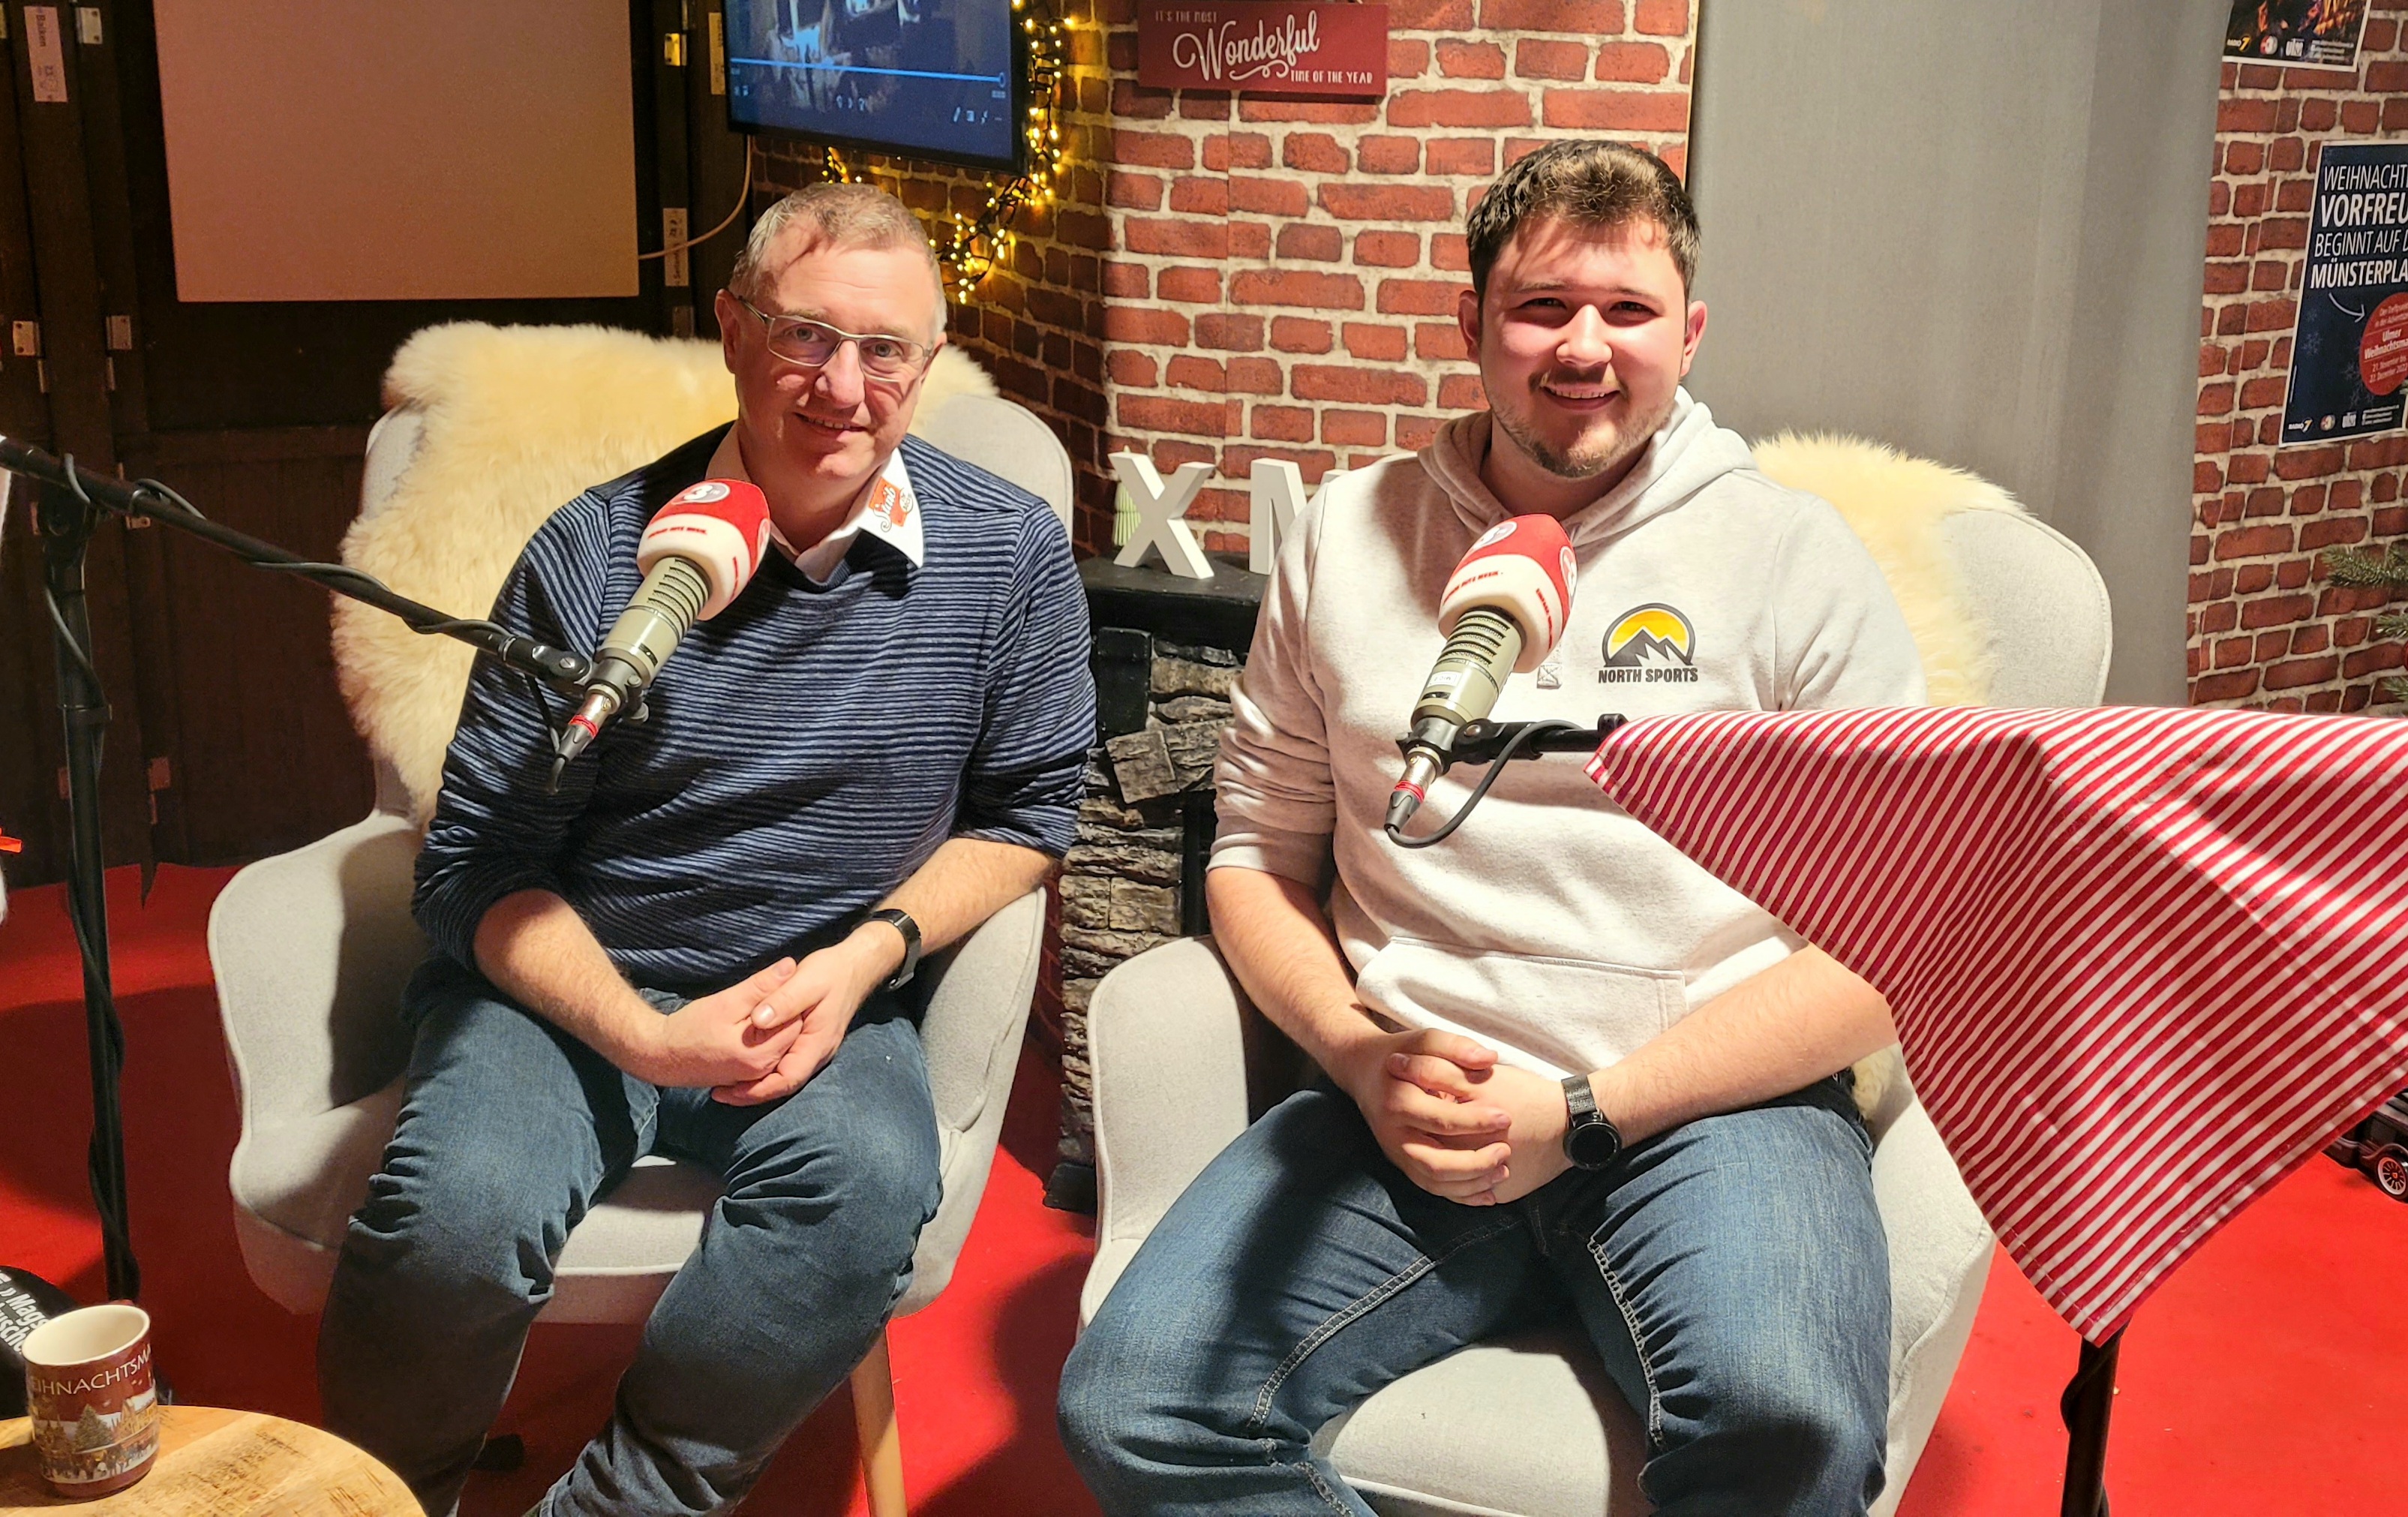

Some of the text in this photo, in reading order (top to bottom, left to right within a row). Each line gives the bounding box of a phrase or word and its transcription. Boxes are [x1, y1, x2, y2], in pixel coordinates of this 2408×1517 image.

[1175, 11, 1190, 23] THE
[1194, 11, 1217, 23] MOST
[1172, 10, 1320, 81] Wonderful
[1291, 70, 1373, 84] TIME OF THE YEAR
[2314, 231, 2373, 257] BEGINNT
[2373, 230, 2402, 254] AUF
[2382, 329, 2401, 342] Ulmer
[1599, 668, 1698, 683] NORTH SPORTS
